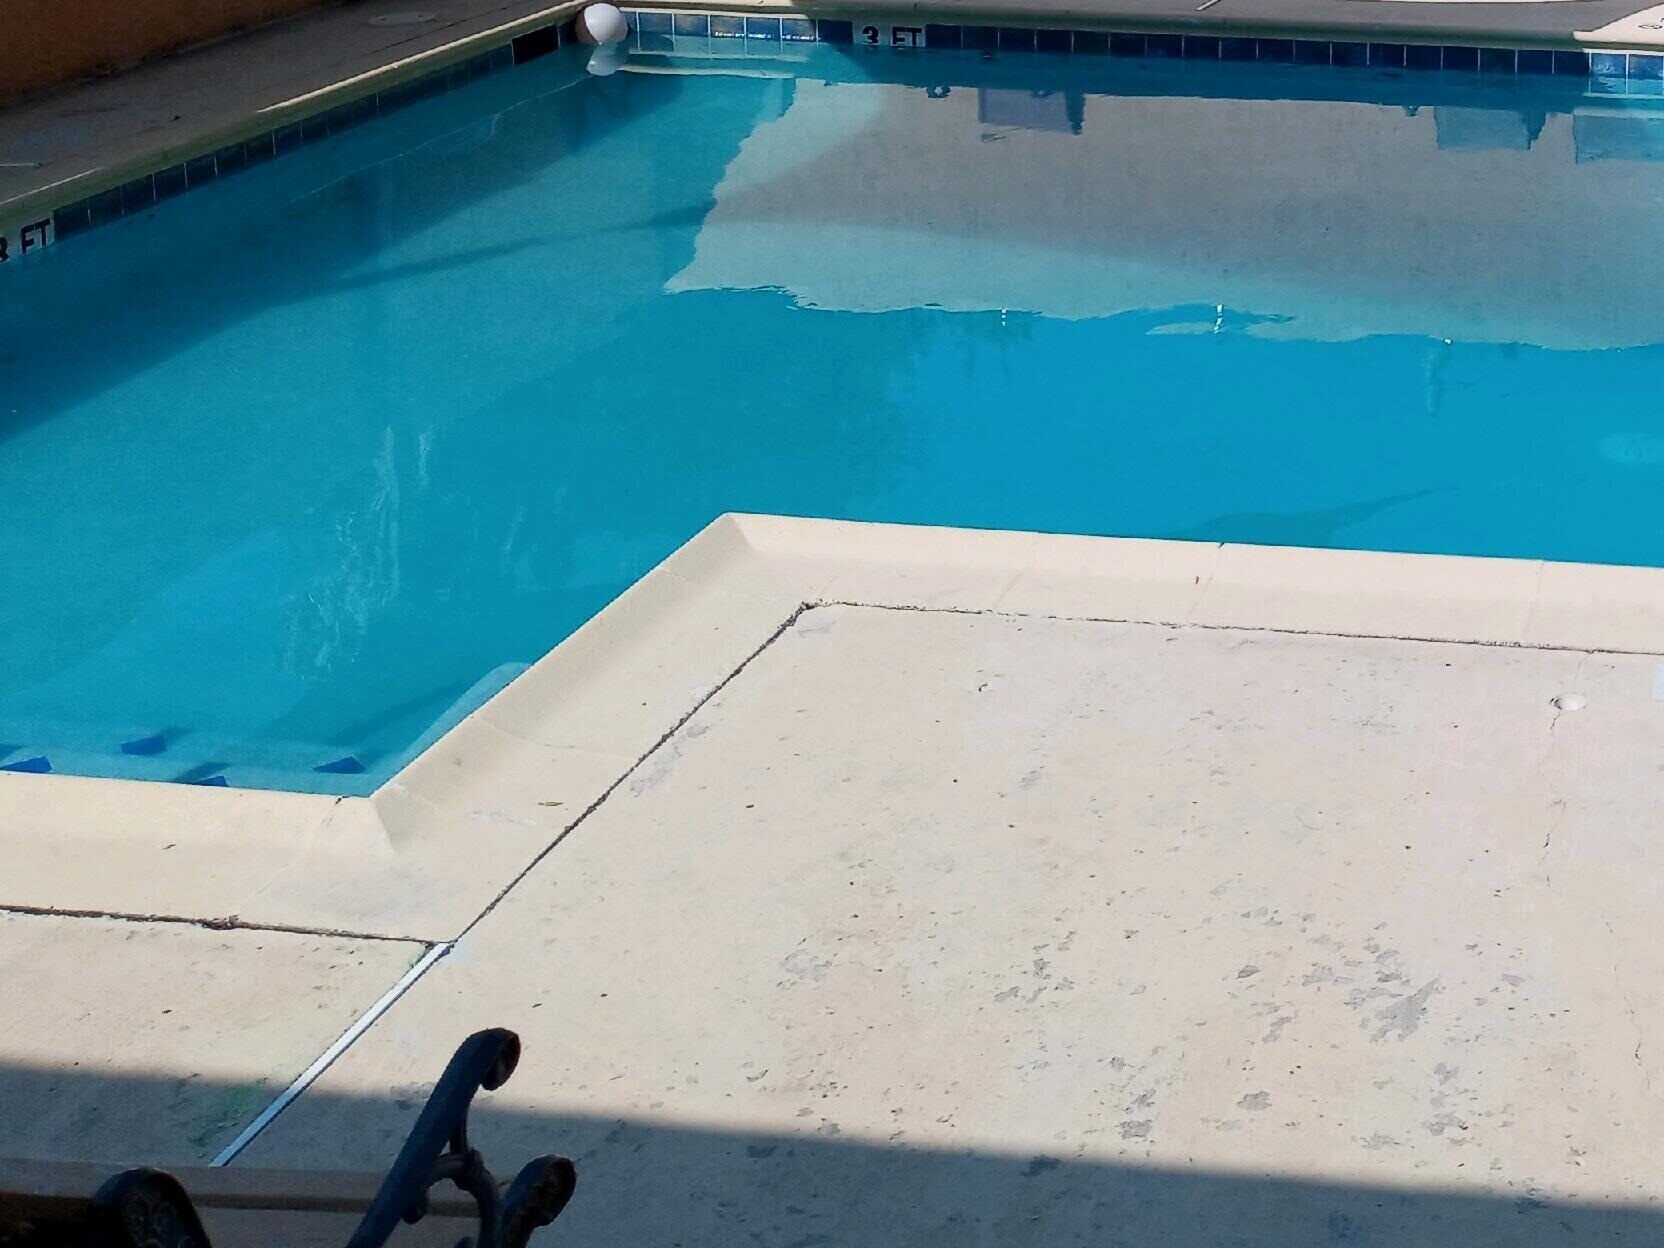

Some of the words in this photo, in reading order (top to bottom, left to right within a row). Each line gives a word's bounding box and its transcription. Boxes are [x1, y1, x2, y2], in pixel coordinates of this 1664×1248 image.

[862, 25, 879, 44] 3
[892, 26, 922, 46] FT
[20, 217, 51, 254] FT
